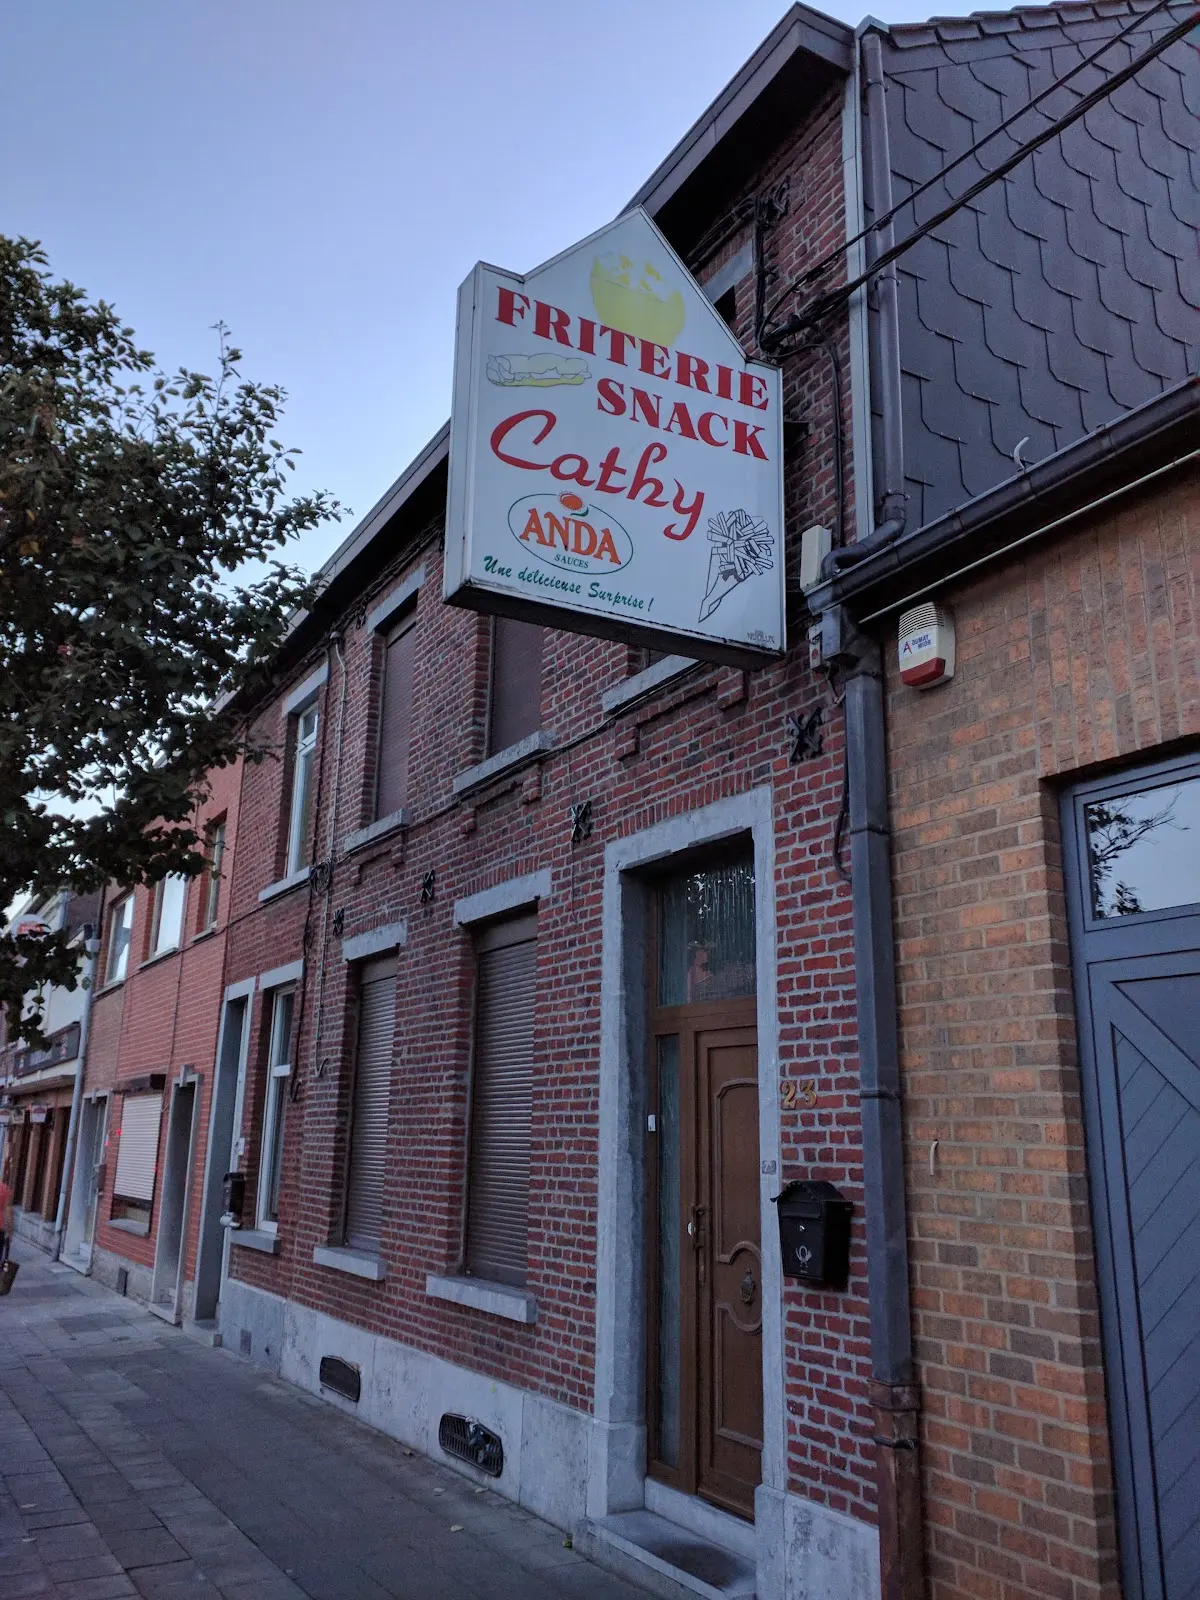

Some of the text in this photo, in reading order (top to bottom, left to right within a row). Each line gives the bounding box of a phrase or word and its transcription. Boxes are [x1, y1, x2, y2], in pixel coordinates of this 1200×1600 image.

[494, 286, 770, 411] FRITERIE
[597, 378, 769, 461] SNACK
[490, 409, 705, 541] Cathy
[519, 507, 622, 566] ANDA
[554, 554, 589, 569] SAUCES
[483, 555, 512, 578] Une
[518, 566, 582, 594] délicieuse
[780, 1079, 817, 1111] 23
